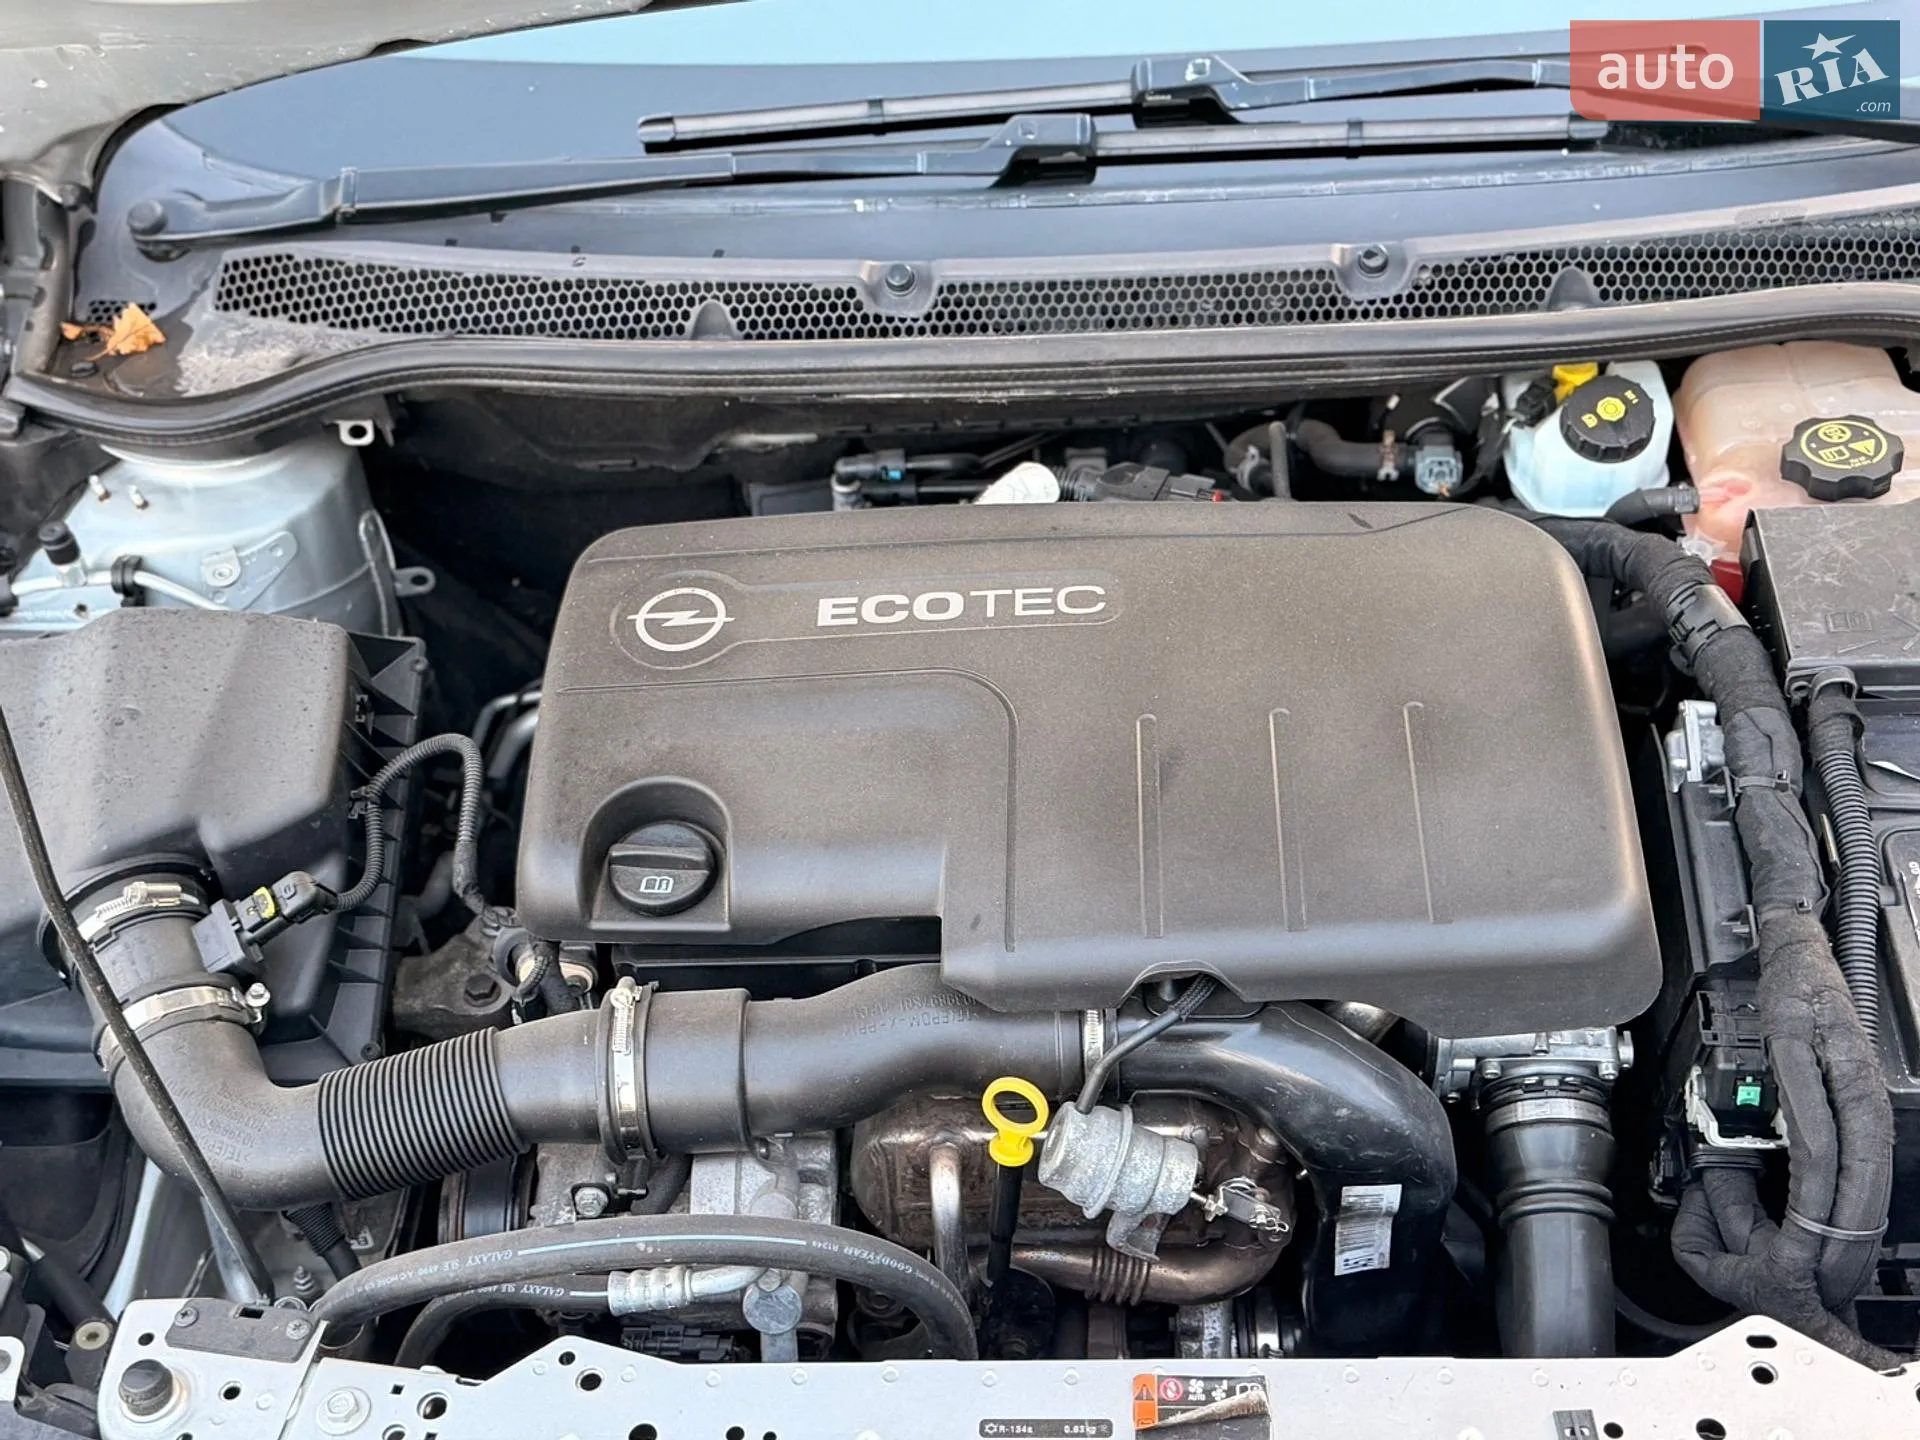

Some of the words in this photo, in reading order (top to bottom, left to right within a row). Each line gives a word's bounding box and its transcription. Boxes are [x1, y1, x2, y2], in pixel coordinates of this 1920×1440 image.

[816, 585, 1106, 627] ECOTEC
[466, 1249, 513, 1267] GALAXY
[520, 1283, 565, 1297] GALAXY
